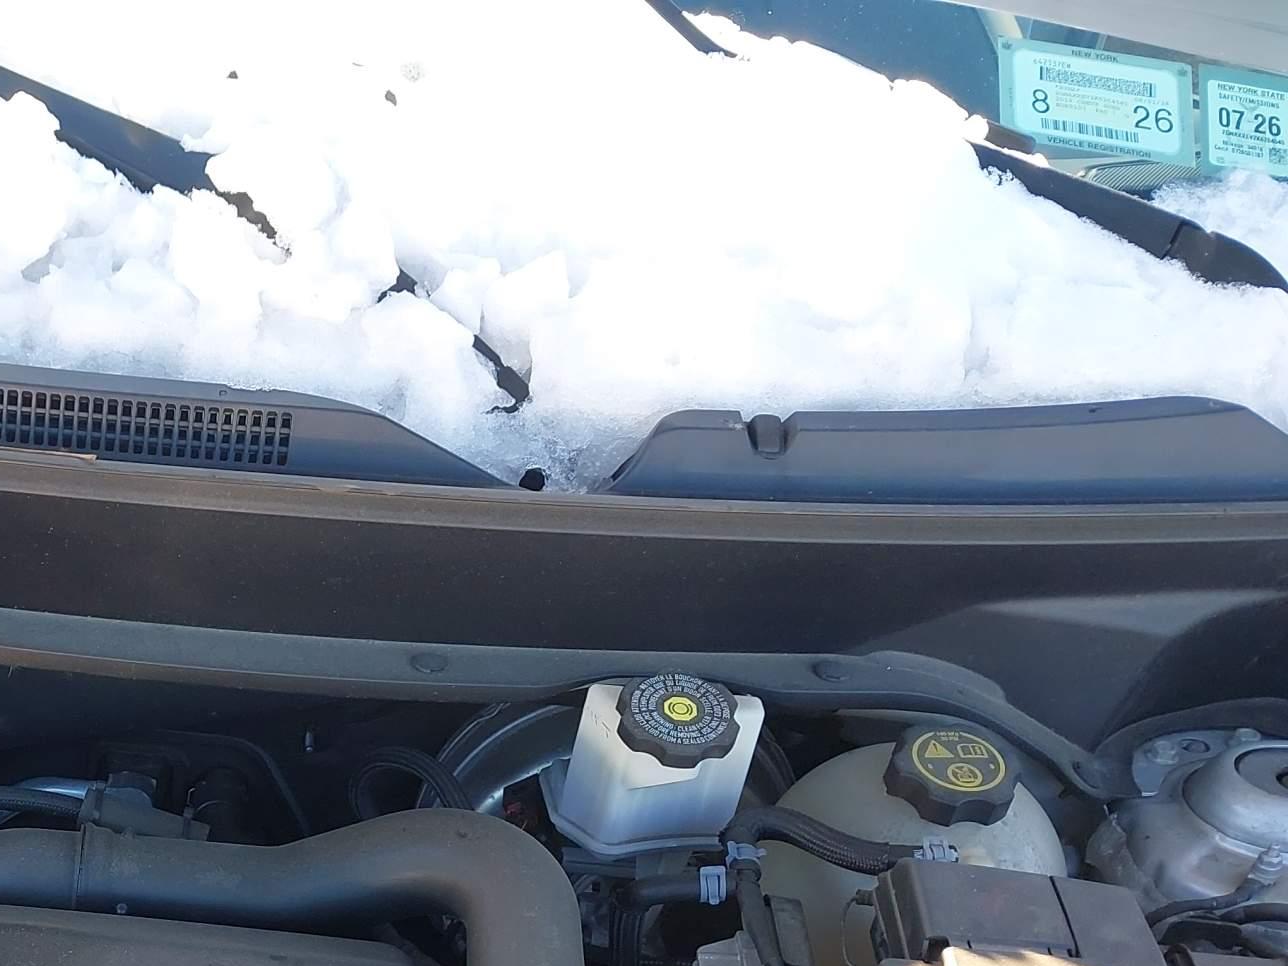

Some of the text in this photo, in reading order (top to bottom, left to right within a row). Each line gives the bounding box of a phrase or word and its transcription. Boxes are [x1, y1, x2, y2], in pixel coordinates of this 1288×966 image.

[1071, 50, 1119, 63] NEW YORK
[1032, 89, 1050, 114] 8
[1217, 83, 1286, 101] NEW YORK STATE
[1133, 105, 1174, 133] 26
[1218, 107, 1281, 136] 07 26
[1047, 135, 1152, 159] VEHICLE REGISTRATION
